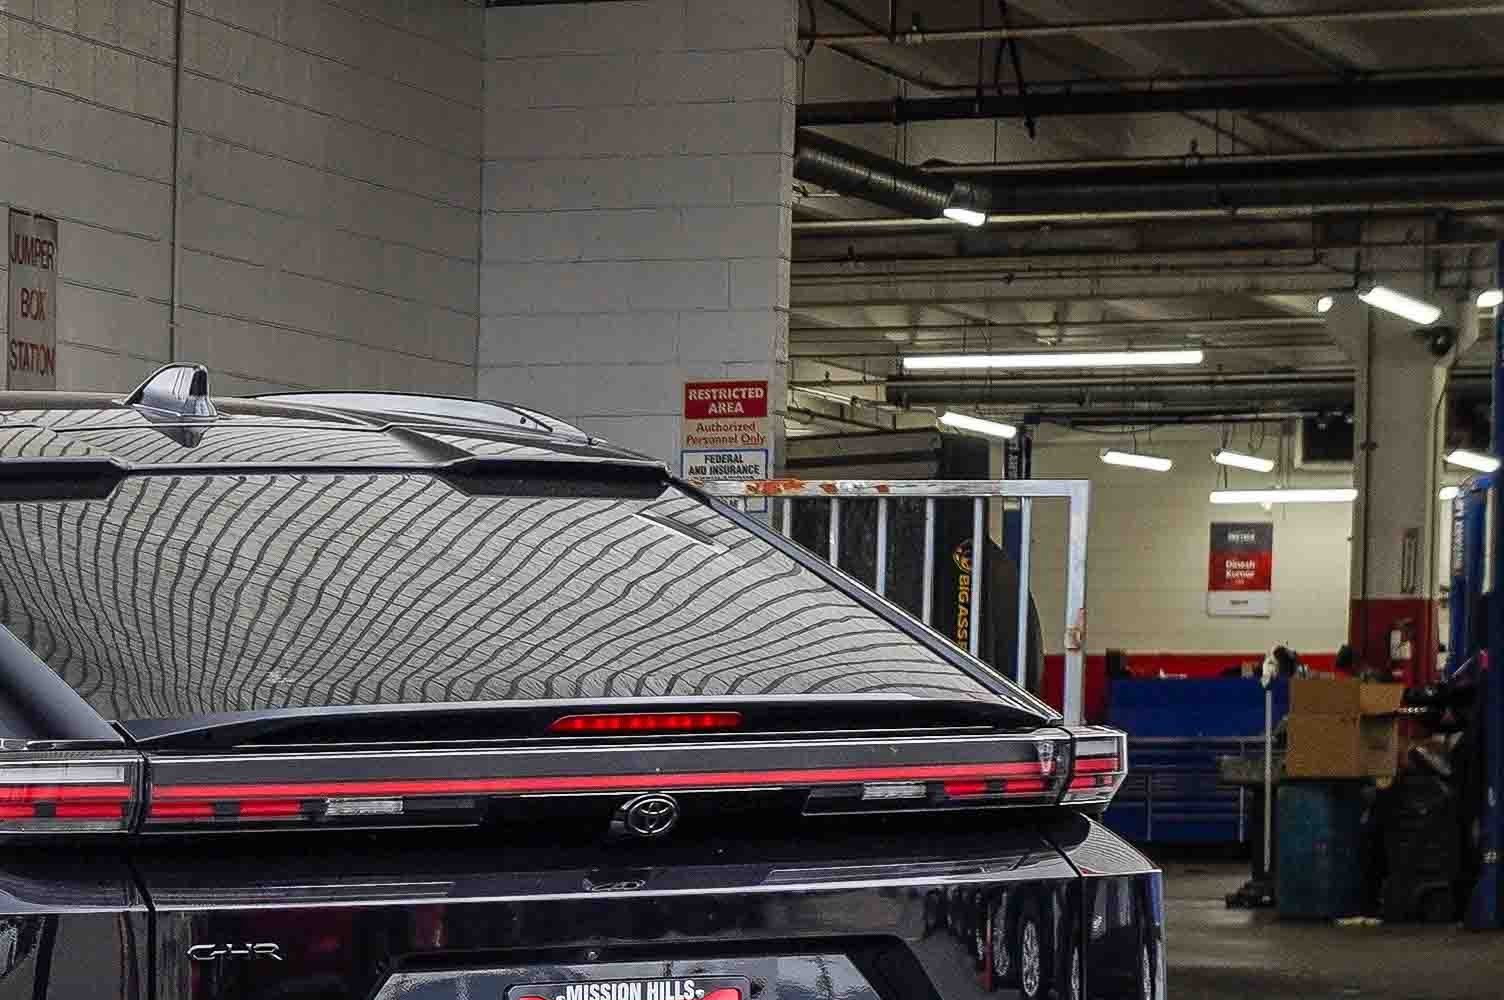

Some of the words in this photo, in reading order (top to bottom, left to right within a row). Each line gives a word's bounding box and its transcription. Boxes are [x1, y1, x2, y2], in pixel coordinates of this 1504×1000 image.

[9, 232, 56, 271] JUMPER
[20, 287, 46, 321] BOX
[9, 339, 56, 376] STATION
[688, 387, 764, 401] RESTRICTED
[708, 402, 745, 414] AREA
[696, 421, 756, 433] Authorized
[687, 433, 738, 446] Personnel
[741, 433, 766, 446] Only
[704, 453, 744, 464] FEDERAL
[688, 464, 707, 475] AND
[709, 464, 761, 475] INSURANCE
[647, 980, 696, 1000] HILLS
